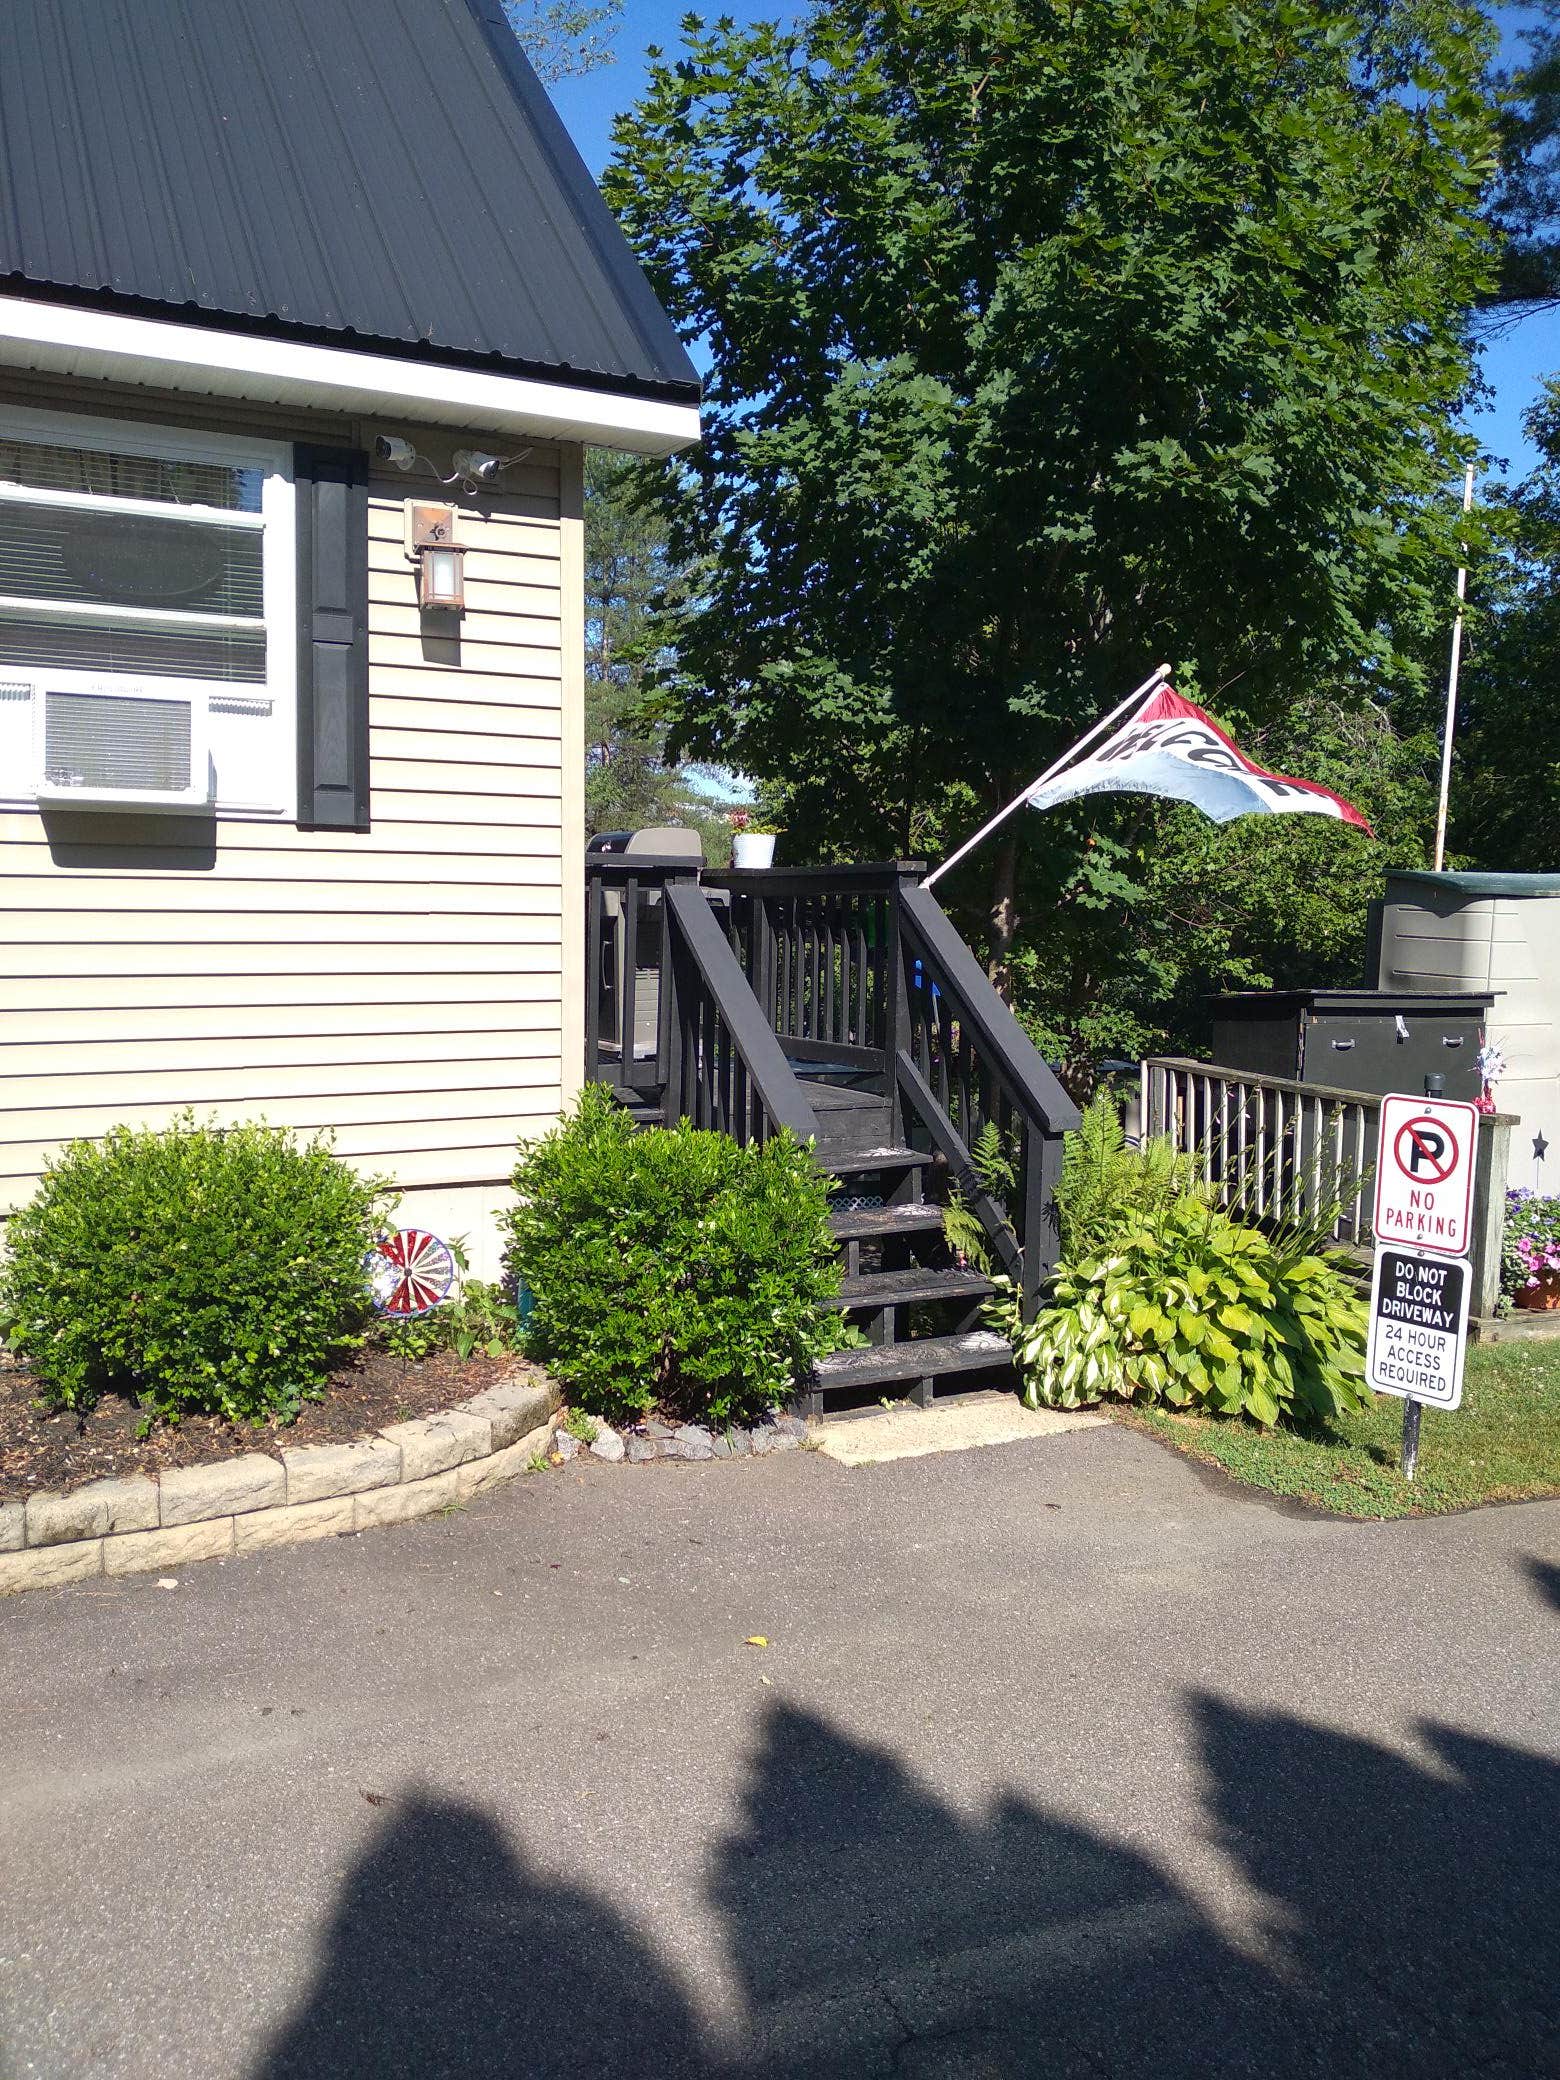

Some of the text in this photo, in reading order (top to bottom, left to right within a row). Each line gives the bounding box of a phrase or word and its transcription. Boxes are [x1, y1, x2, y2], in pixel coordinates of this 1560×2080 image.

[1410, 1129, 1445, 1173] P
[1410, 1189, 1435, 1211] NO
[1386, 1207, 1457, 1238] PARKING
[1395, 1261, 1448, 1286] DO NOT
[1396, 1281, 1442, 1306] BLOCK
[1382, 1297, 1455, 1328] DRIVEWAY
[1385, 1324, 1446, 1352] 24 HOUR
[1387, 1345, 1441, 1371] ACCESS
[1379, 1361, 1447, 1392] REQUIRED
